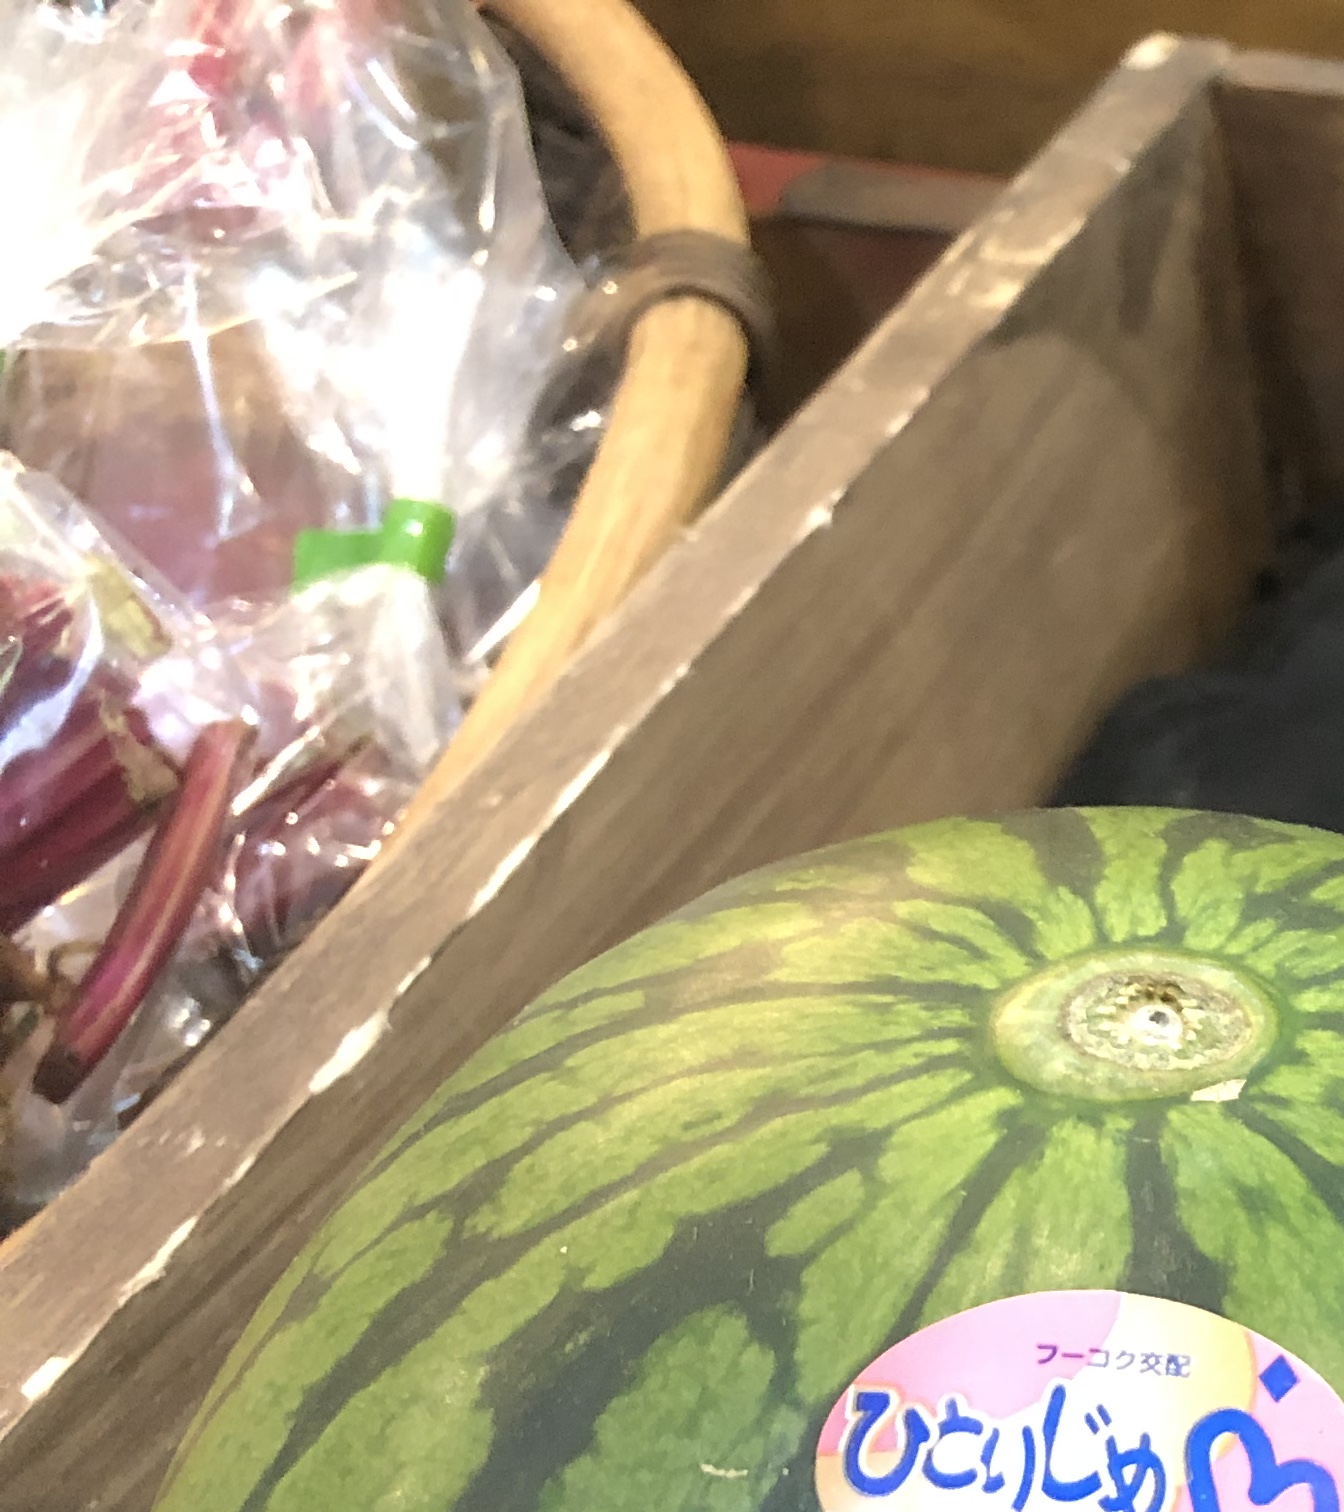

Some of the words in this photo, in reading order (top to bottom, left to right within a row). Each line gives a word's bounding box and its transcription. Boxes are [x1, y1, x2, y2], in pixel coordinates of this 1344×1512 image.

[1036, 1343, 1192, 1379] フーコク交配
